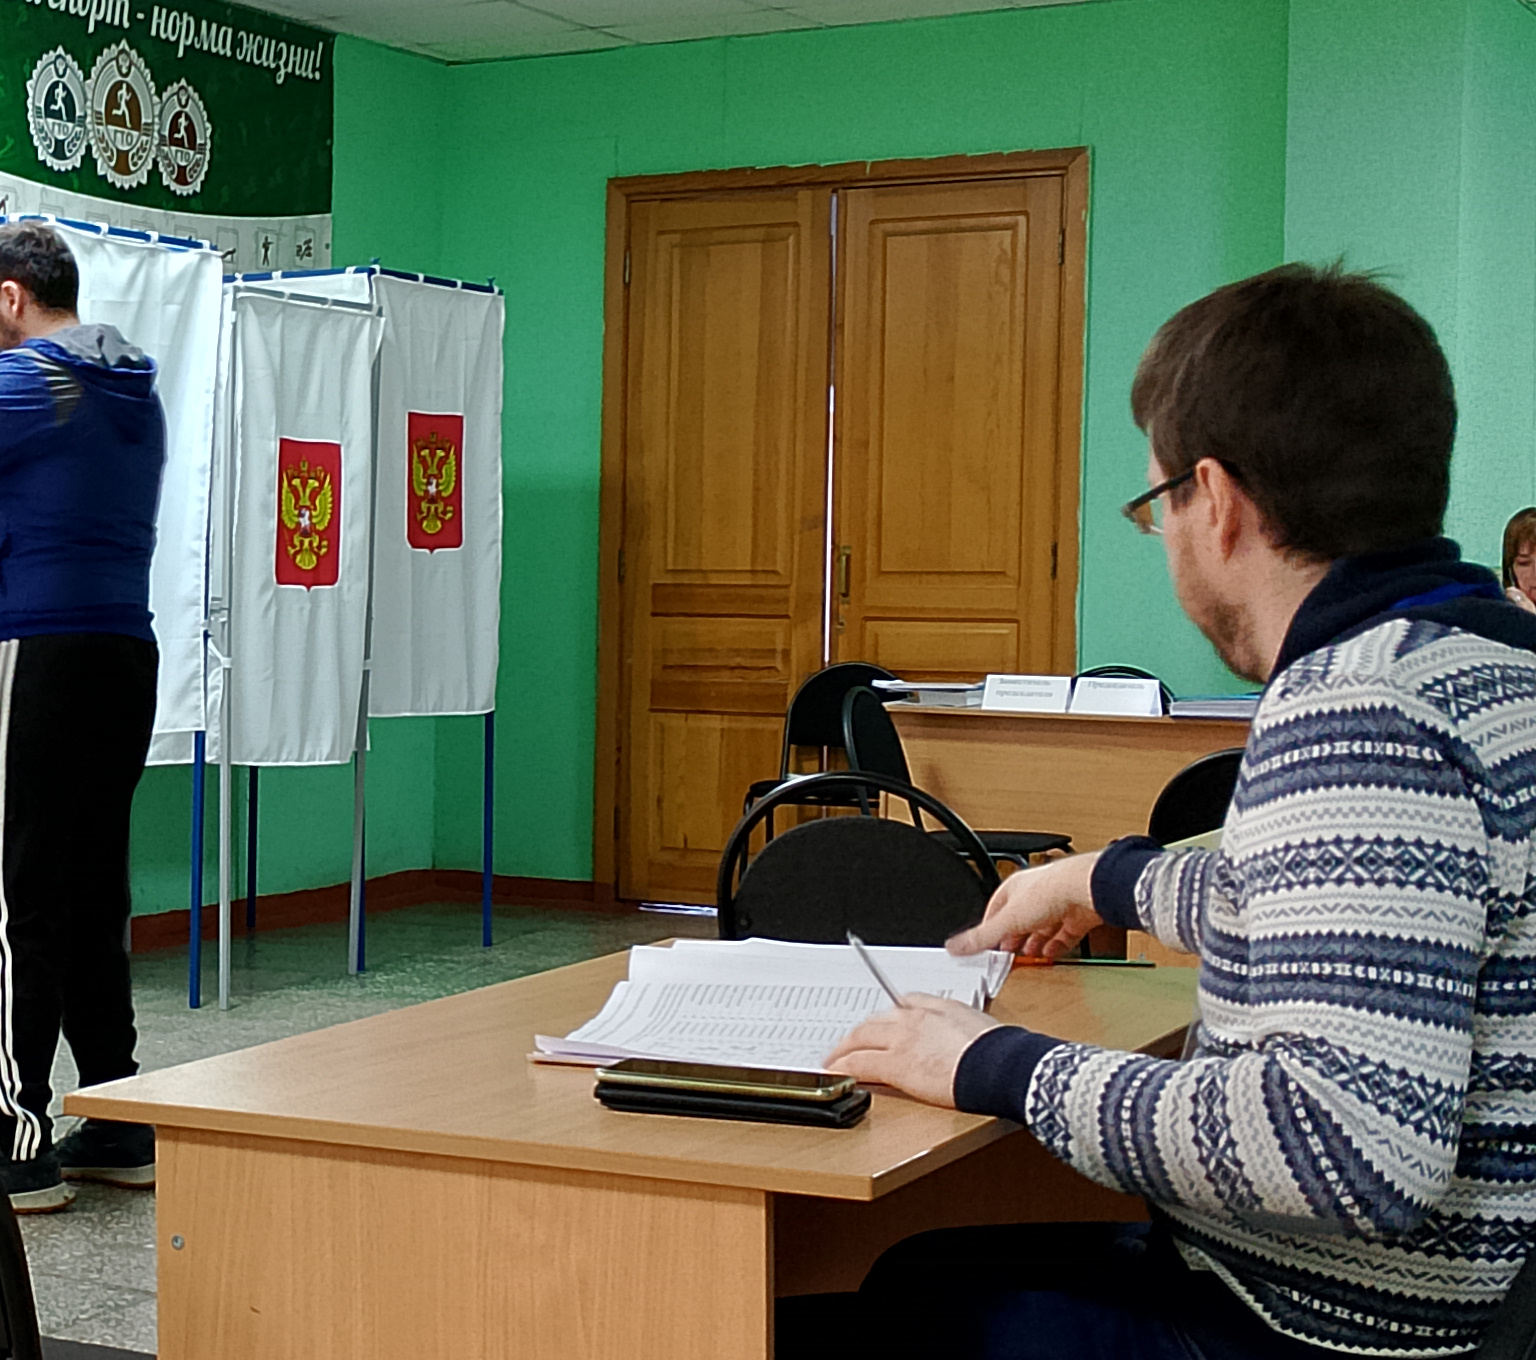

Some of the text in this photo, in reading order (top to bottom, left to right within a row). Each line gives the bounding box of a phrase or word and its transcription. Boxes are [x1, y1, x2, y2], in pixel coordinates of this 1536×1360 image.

[150, 5, 233, 58] норма
[236, 30, 323, 84] жизни!
[51, 121, 70, 136] ГТО
[113, 129, 134, 147] ГТО
[174, 149, 191, 163] ГТО
